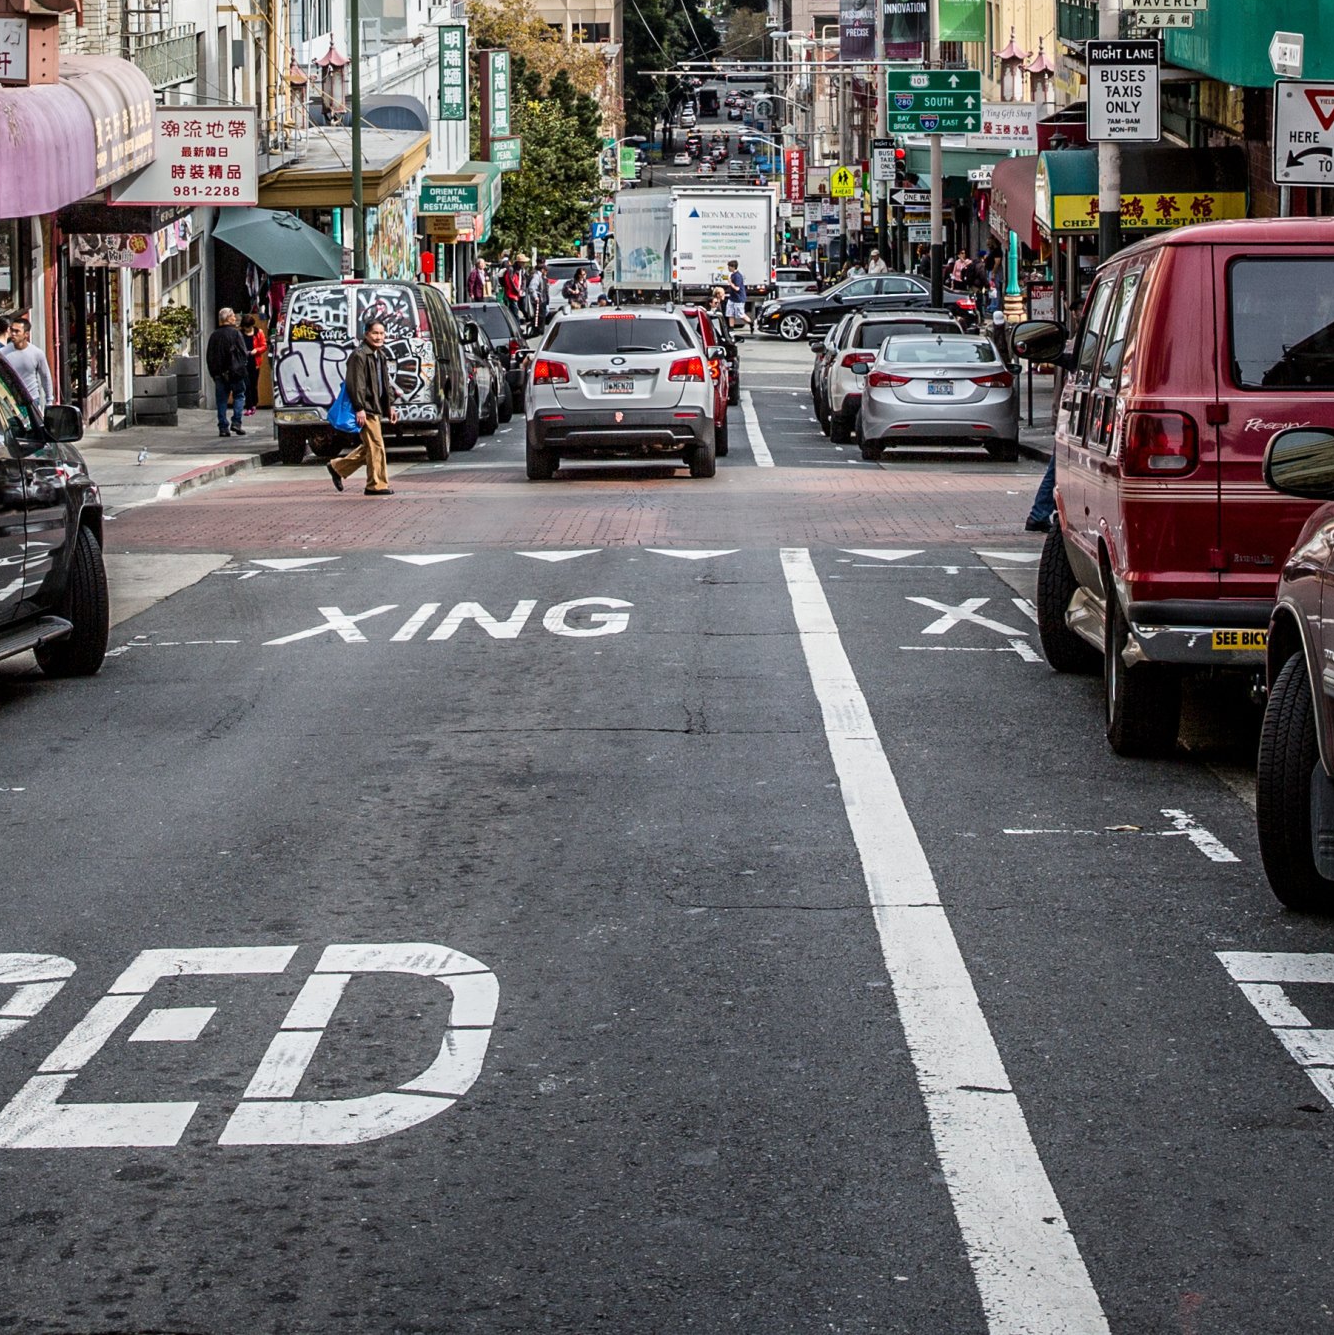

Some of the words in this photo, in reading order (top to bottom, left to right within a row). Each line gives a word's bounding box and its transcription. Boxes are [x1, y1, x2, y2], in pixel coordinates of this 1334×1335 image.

[885, 3, 926, 14] INNOVATION
[846, 28, 869, 37] PRECISE
[1092, 49, 1122, 59] RIGHT
[1126, 49, 1154, 59] LANE
[1101, 70, 1146, 82] BUSES
[1105, 85, 1142, 97] TAXIS
[925, 97, 953, 106] SOUTH
[1106, 101, 1140, 113] ONLY
[161, 120, 246, 138] 潮流地帶
[1289, 131, 1319, 143] HERE
[172, 165, 241, 179] 時裝精品
[1319, 161, 1332, 172] TO
[173, 186, 240, 196] 981-2288
[424, 203, 474, 211] RESTAURANT
[1063, 219, 1096, 227] CHEF
[261, 596, 635, 646] XING
[1215, 632, 1238, 645] SEE
